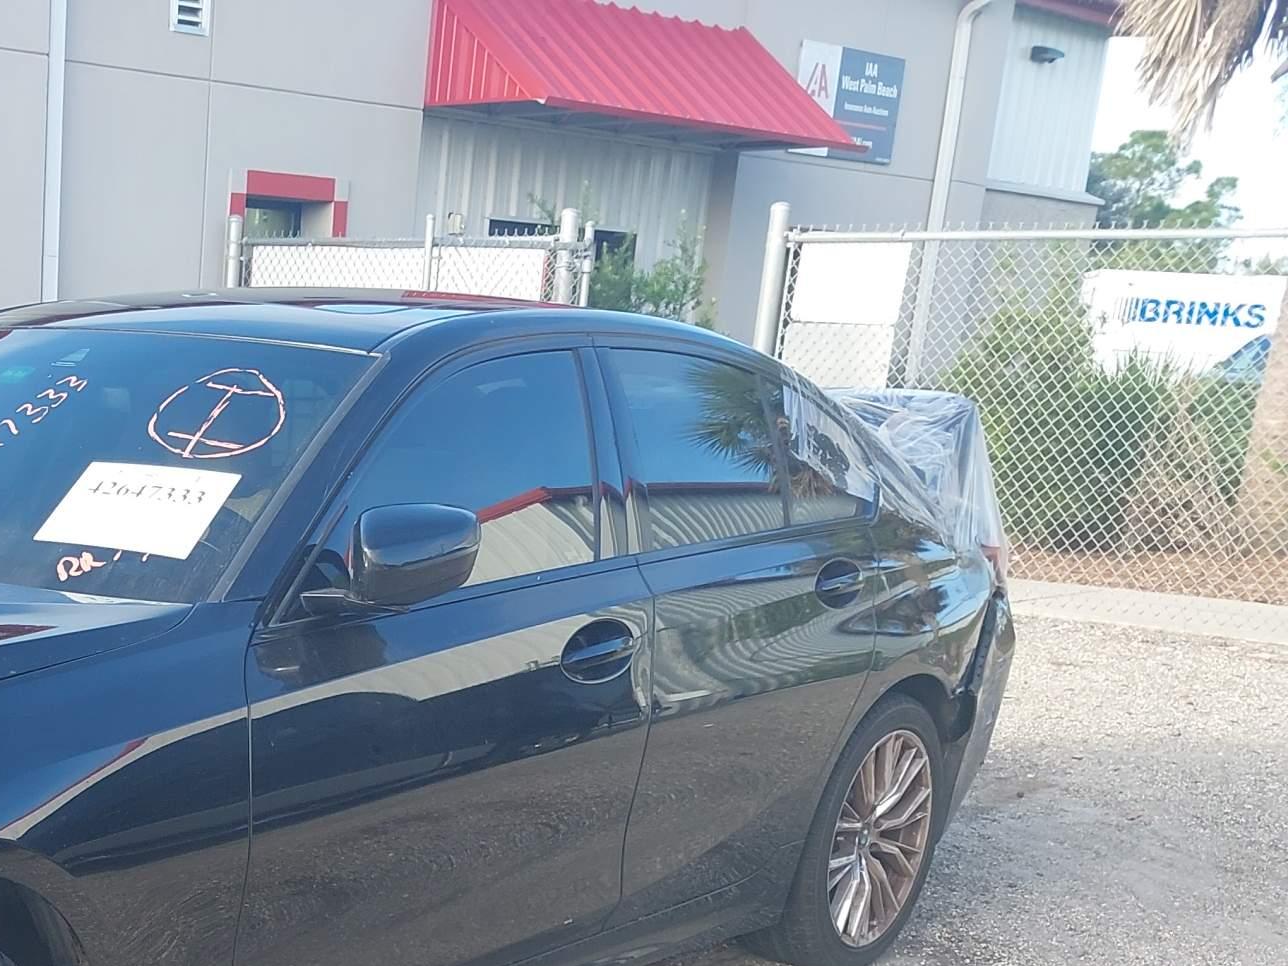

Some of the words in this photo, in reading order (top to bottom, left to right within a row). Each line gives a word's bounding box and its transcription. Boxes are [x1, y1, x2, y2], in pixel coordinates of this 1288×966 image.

[864, 61, 878, 78] IAA
[841, 75, 859, 92] West
[859, 78, 876, 95] Palm
[876, 81, 898, 99] Beach
[1139, 298, 1267, 329] BRINKS
[88, 480, 207, 505] 42647333
